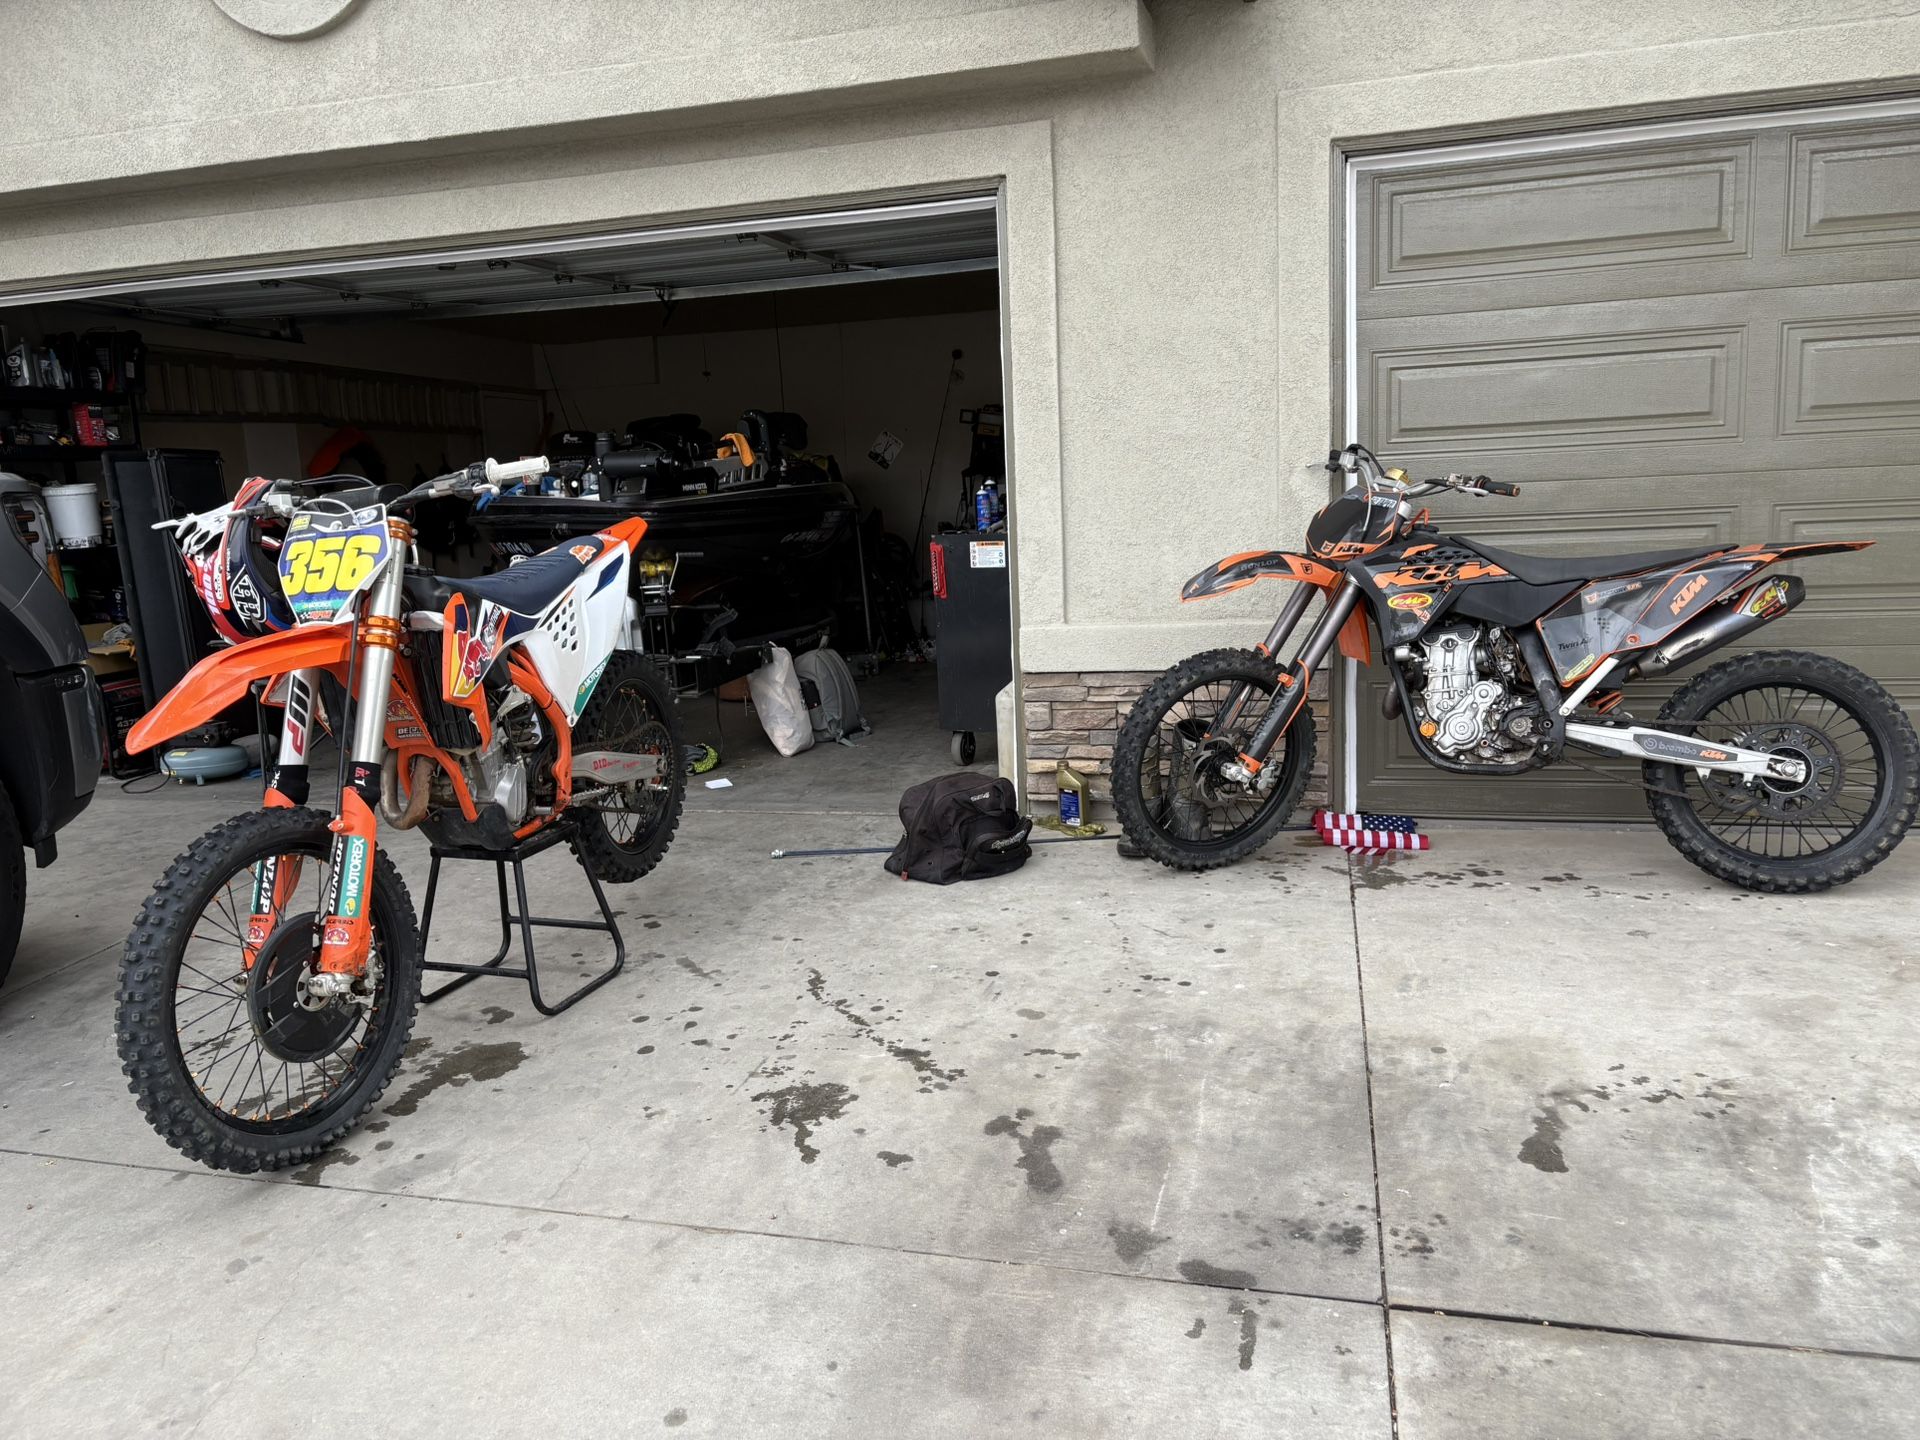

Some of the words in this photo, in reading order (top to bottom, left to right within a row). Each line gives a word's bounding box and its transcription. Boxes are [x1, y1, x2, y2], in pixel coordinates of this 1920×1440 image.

[1337, 544, 1364, 553] KTM
[281, 535, 381, 596] 356
[1241, 559, 1278, 571] DUNLOP
[1391, 596, 1428, 605] FMF
[1670, 575, 1709, 616] KTM
[1751, 583, 1783, 613] FM
[1558, 641, 1579, 651] Twin
[287, 674, 310, 756] WP
[592, 758, 607, 770] DID
[1659, 740, 1697, 755] brembo
[1700, 750, 1728, 761] KTM
[328, 837, 344, 914] DUNLOP
[346, 838, 365, 897] MOTOREX
[260, 856, 276, 914] NLOP
